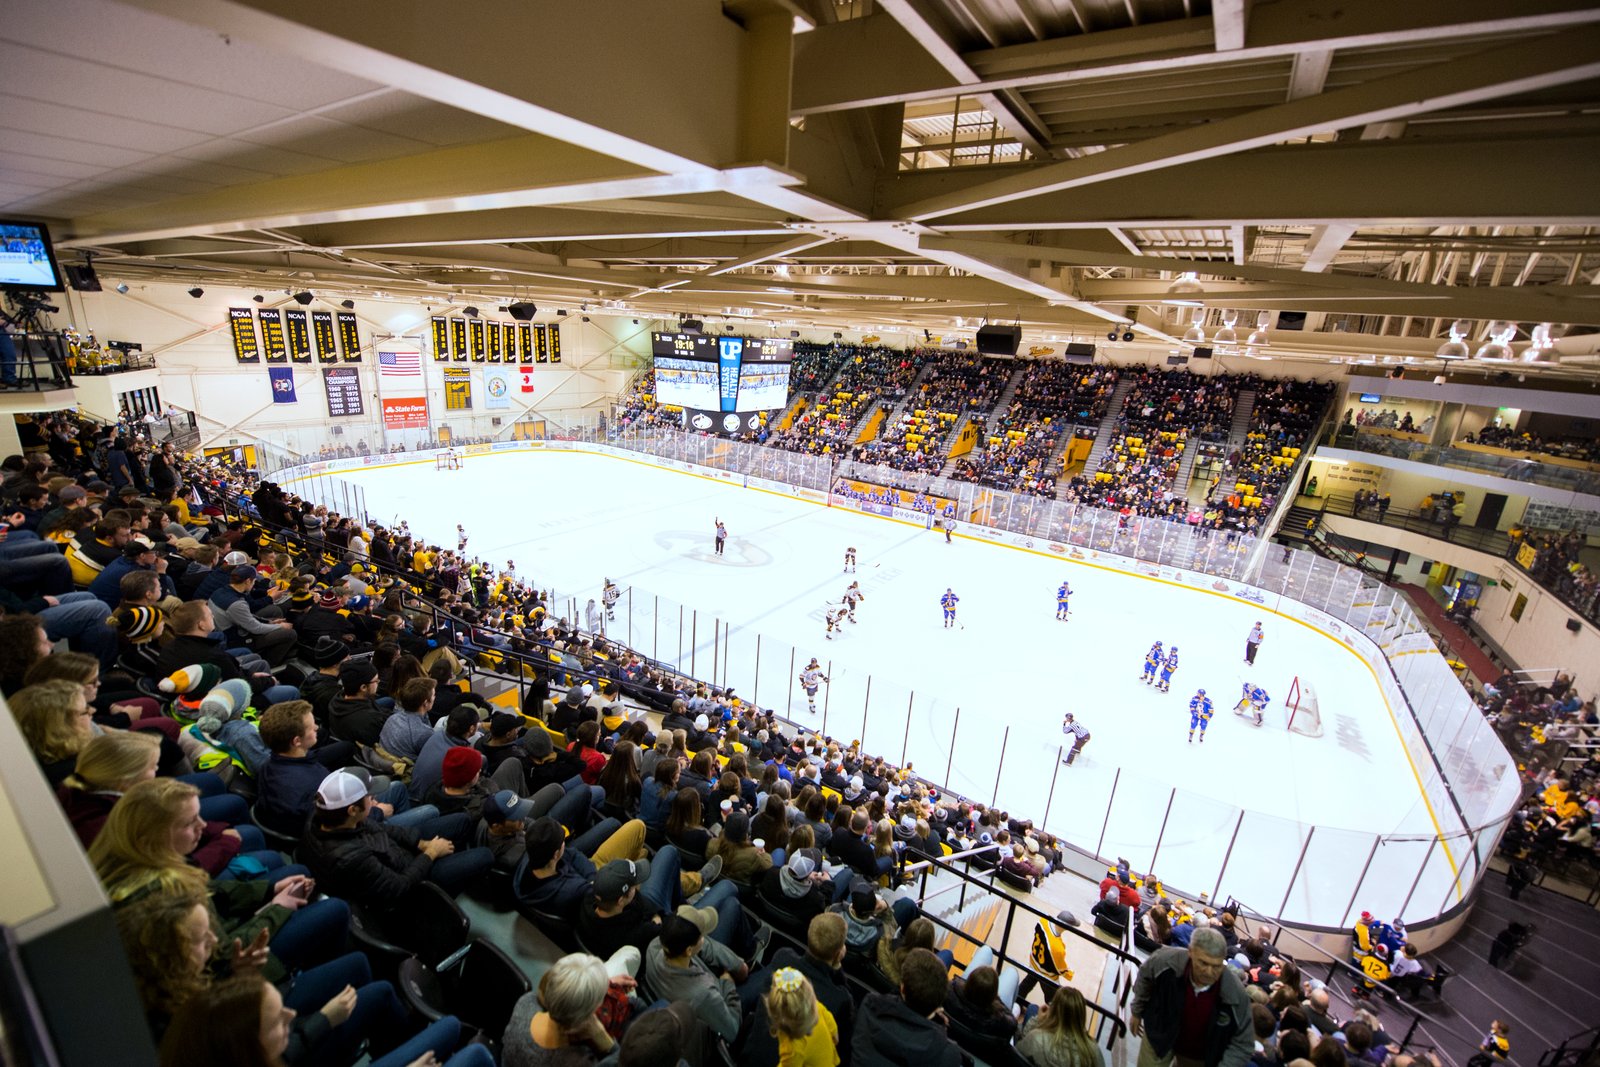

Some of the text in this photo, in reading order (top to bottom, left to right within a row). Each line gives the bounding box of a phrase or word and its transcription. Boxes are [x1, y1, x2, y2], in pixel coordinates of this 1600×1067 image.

[655, 333, 660, 341] 3
[710, 338, 716, 346] 2
[674, 339, 695, 350] 19:16
[719, 340, 742, 361] UP
[721, 366, 730, 399] SYSTEM
[729, 367, 739, 399] HEALTH
[608, 590, 617, 599] 15
[1367, 961, 1383, 977] 12
